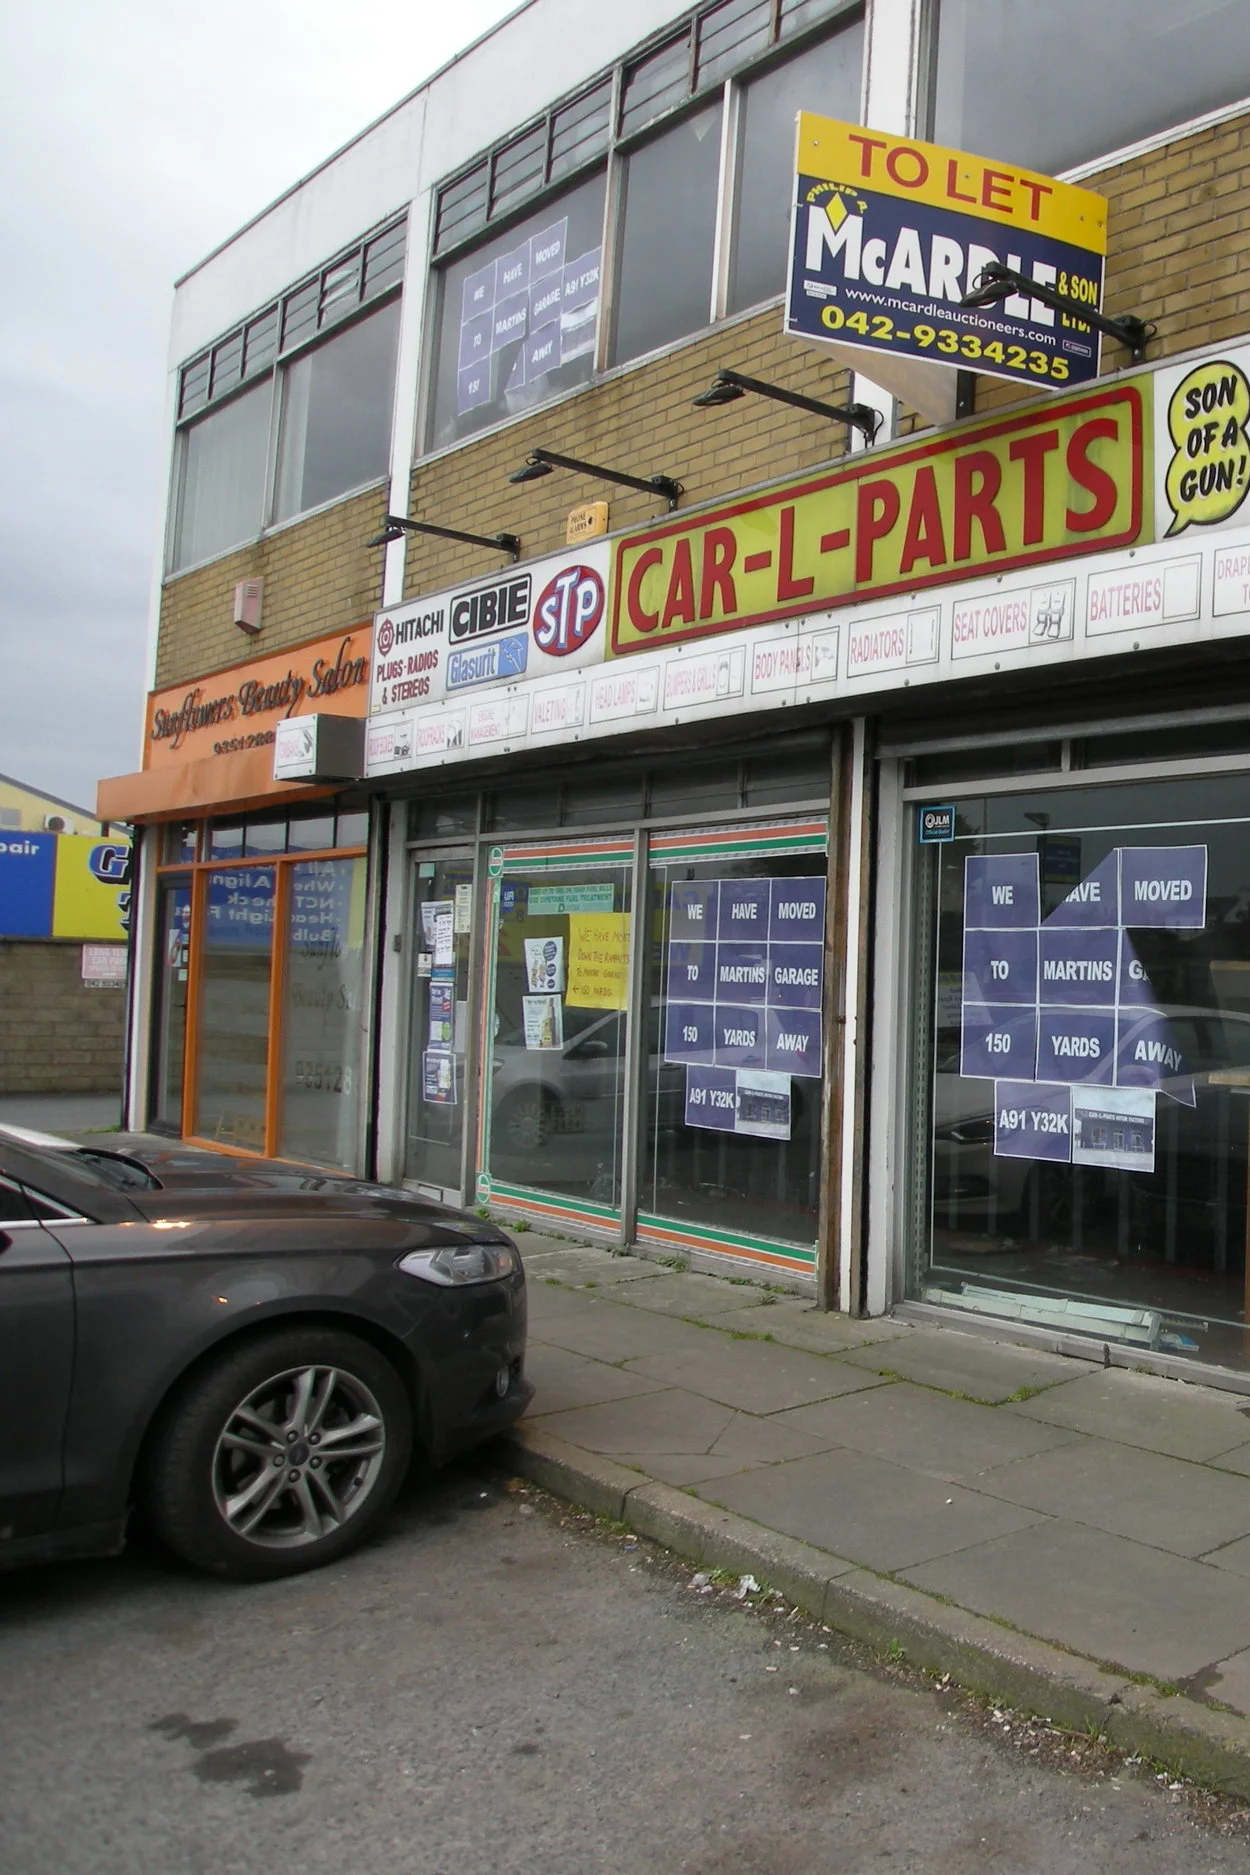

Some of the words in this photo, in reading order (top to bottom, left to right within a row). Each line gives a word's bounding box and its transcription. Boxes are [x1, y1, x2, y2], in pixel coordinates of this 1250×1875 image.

[848, 133, 930, 189] TO
[946, 158, 1054, 222] LET
[503, 263, 523, 284] HAVE
[535, 241, 560, 265] MOVED
[579, 266, 600, 289] Y32K
[805, 204, 1057, 327] McARDLE
[1058, 271, 1069, 296] &
[1070, 275, 1098, 306] SON
[845, 288, 1057, 347] www.mcardleauctioneers.com
[821, 304, 1070, 381] 042-9334235
[1185, 375, 1238, 420] SON
[1187, 421, 1219, 459] OF
[1221, 416, 1239, 448] A
[1179, 454, 1248, 504] GUN!
[627, 417, 1119, 633] CAR-L-PARTS
[452, 580, 529, 638] CIBIE
[537, 567, 599, 649] STP
[1089, 578, 1162, 622] BATTERIES
[395, 609, 444, 645] HITACHI
[954, 608, 981, 643] SEAT
[983, 601, 1028, 637] COVERS
[754, 651, 778, 680] BODY
[779, 644, 812, 677] PANELS
[850, 628, 905, 665] RADIATORS
[449, 647, 497, 684] Glasurit
[151, 688, 234, 750] Sunflowers
[238, 670, 304, 718] Beauty
[307, 636, 367, 698] Salon
[381, 687, 388, 705] &
[391, 677, 431, 703] STEREOS
[534, 698, 567, 725] VALETING
[687, 904, 703, 920] WE
[731, 903, 758, 920] HAVE
[778, 902, 817, 920] MOVED
[992, 886, 1014, 905] WE
[1065, 882, 1100, 902] AVE
[1134, 881, 1192, 901] MOVED
[687, 965, 699, 981] TO
[720, 966, 766, 983] MARTINS
[774, 967, 819, 986] GARAGE
[990, 960, 1009, 980] TO
[1044, 960, 1113, 981] MARTINS
[682, 1026, 698, 1044] 150
[723, 1030, 756, 1047] YARDS
[776, 1033, 809, 1052] AWAY
[985, 1034, 1011, 1054] 150
[1052, 1036, 1100, 1058] YARDS
[1134, 1039, 1182, 1072] AWAY
[689, 1089, 707, 1106] A91
[710, 1090, 735, 1108] Y32K
[999, 1110, 1026, 1130] A91
[1032, 1112, 1069, 1134] Y32K
